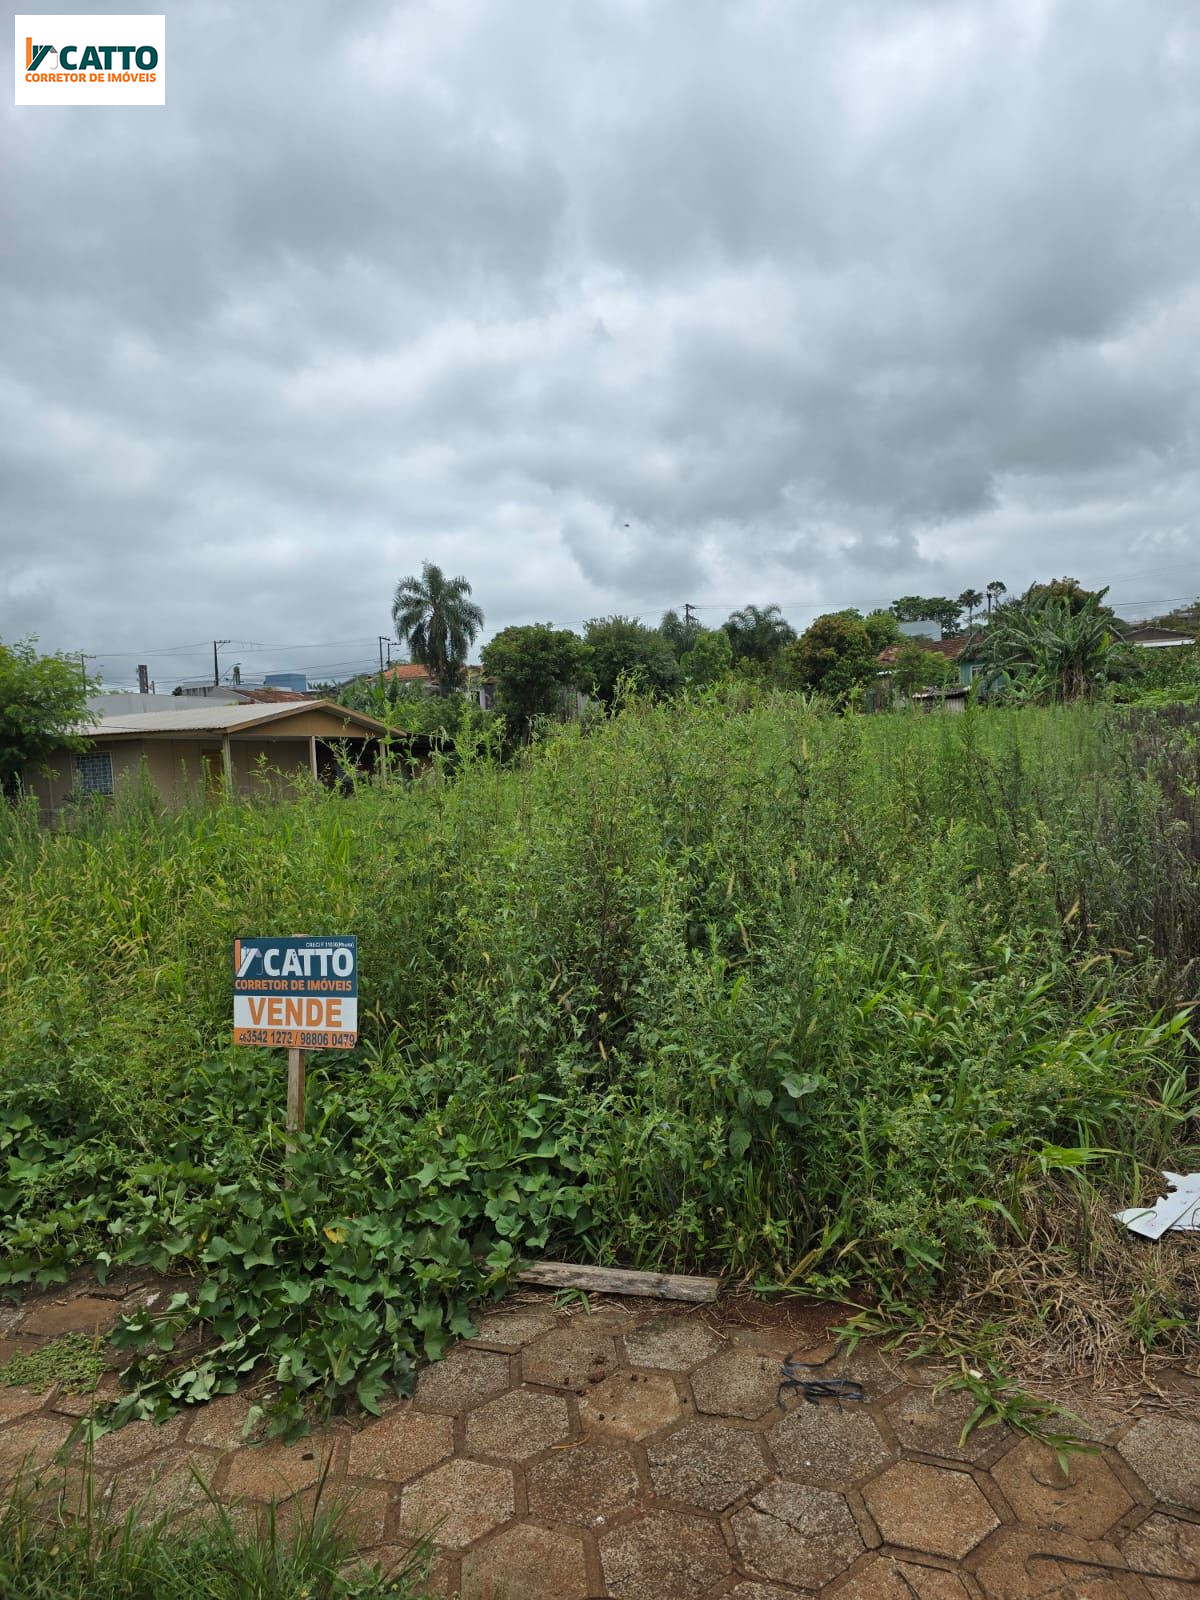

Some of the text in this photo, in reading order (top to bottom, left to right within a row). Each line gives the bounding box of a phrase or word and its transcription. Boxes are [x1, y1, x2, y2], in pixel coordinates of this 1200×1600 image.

[263, 948, 354, 977] CATTO
[235, 978, 353, 991] CORRETOR DE IMÓVEIS
[247, 997, 343, 1028] VENDE
